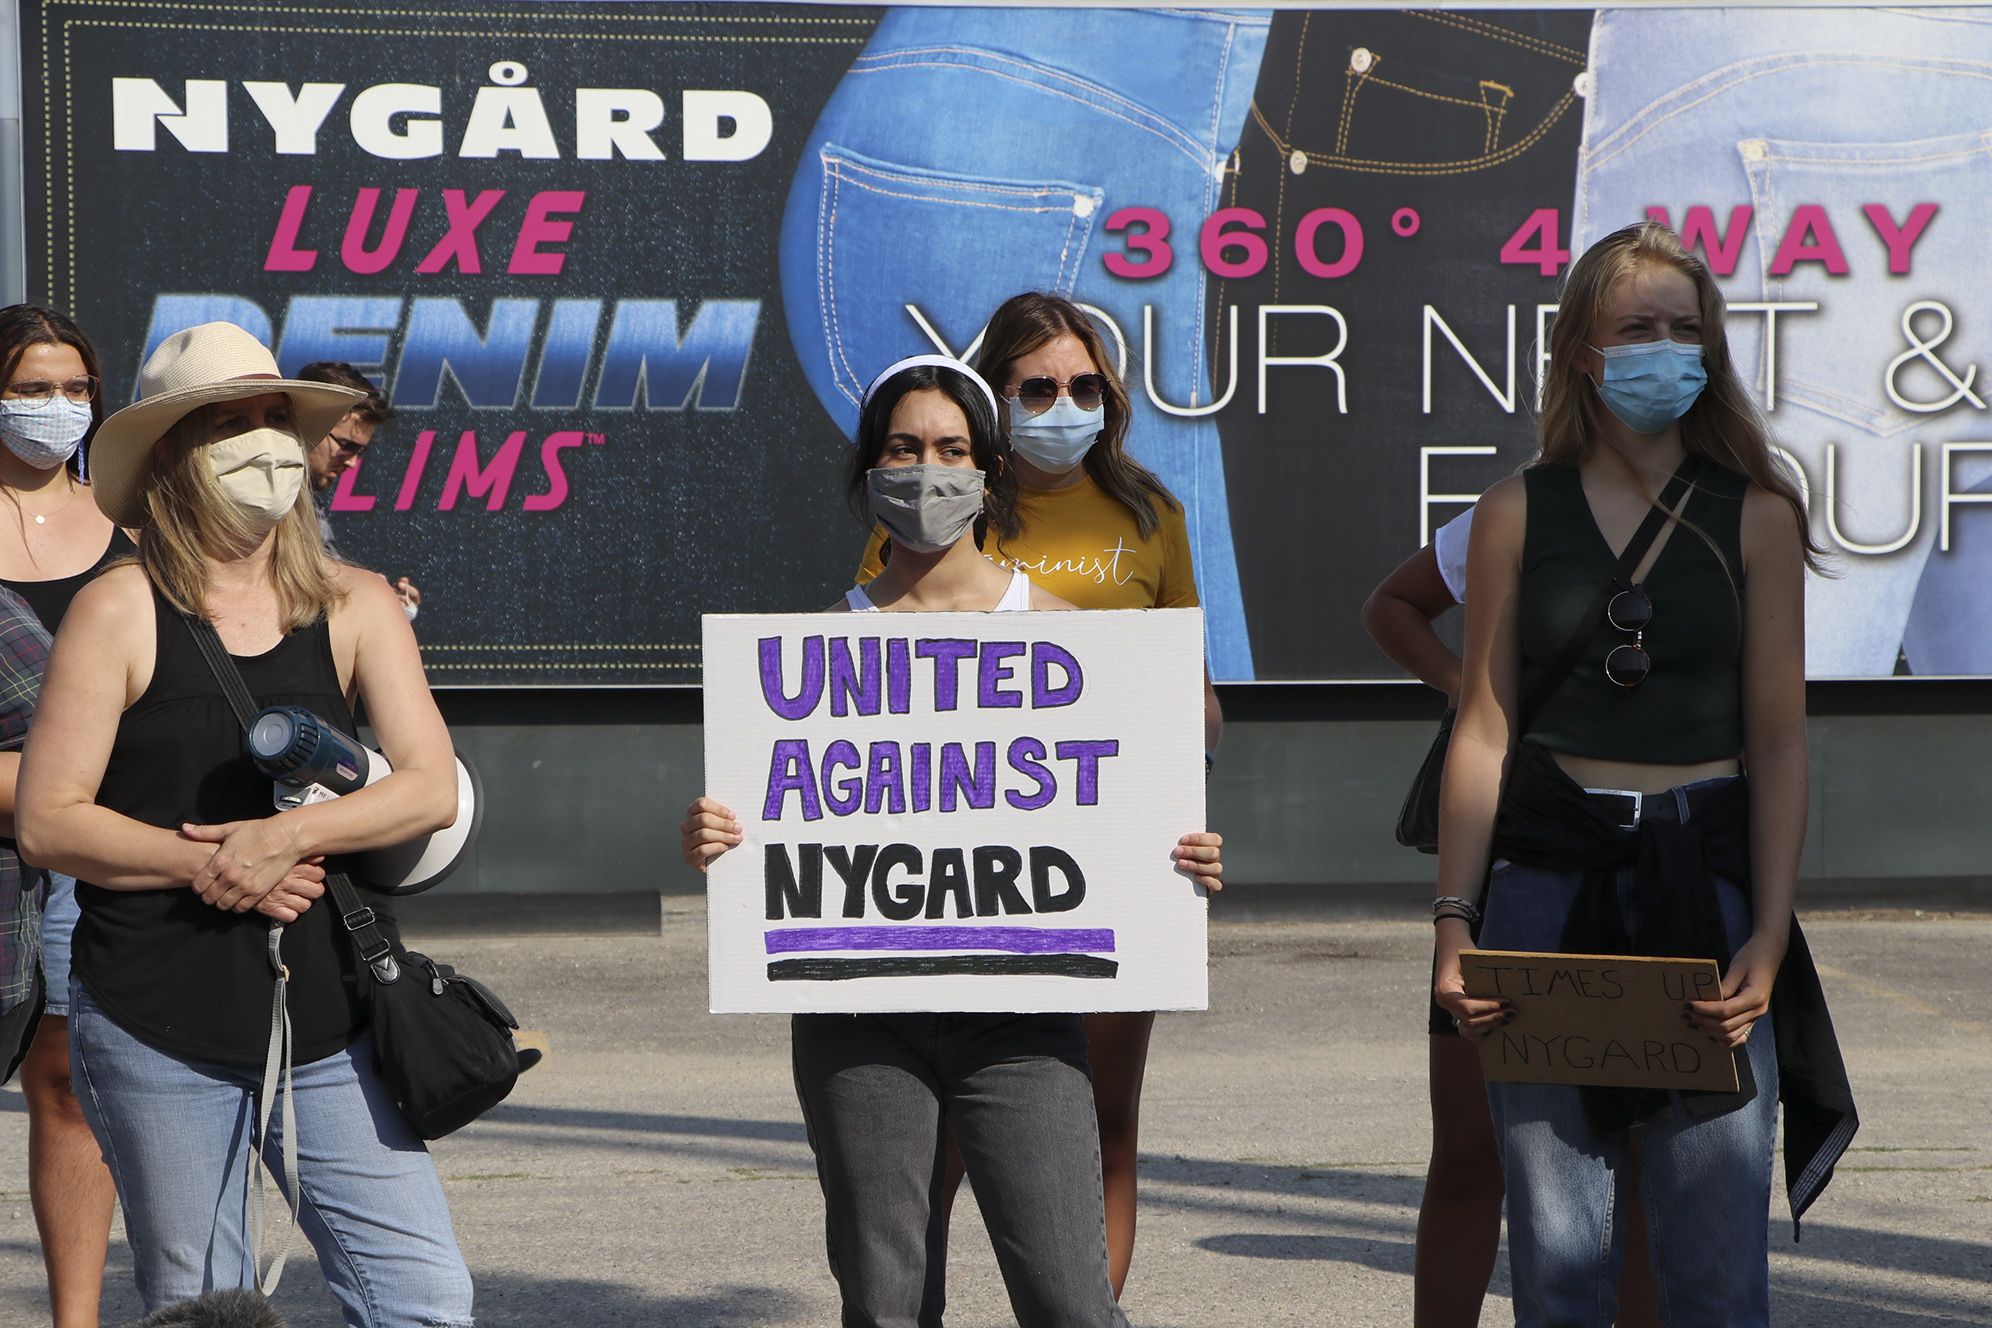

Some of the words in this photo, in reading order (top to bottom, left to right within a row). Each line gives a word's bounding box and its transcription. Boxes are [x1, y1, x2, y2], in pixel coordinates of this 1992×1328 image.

[112, 61, 774, 162] NYGÅRD
[263, 185, 586, 275] LUXE
[1102, 206, 1421, 278] 360°
[1500, 207, 1570, 277] 4
[1646, 202, 1940, 277] WAY
[1423, 301, 1818, 414] NT
[1885, 301, 1987, 413] &
[330, 430, 606, 513] LIMS™
[983, 536, 1137, 586] minist
[757, 635, 1084, 721] UNITED
[762, 736, 1119, 822] AGAINST
[764, 843, 1087, 920] NYGARD
[1477, 966, 1624, 1000] TIMES
[1662, 972, 1715, 1001] UP
[1503, 1034, 1702, 1074] NYGARD
